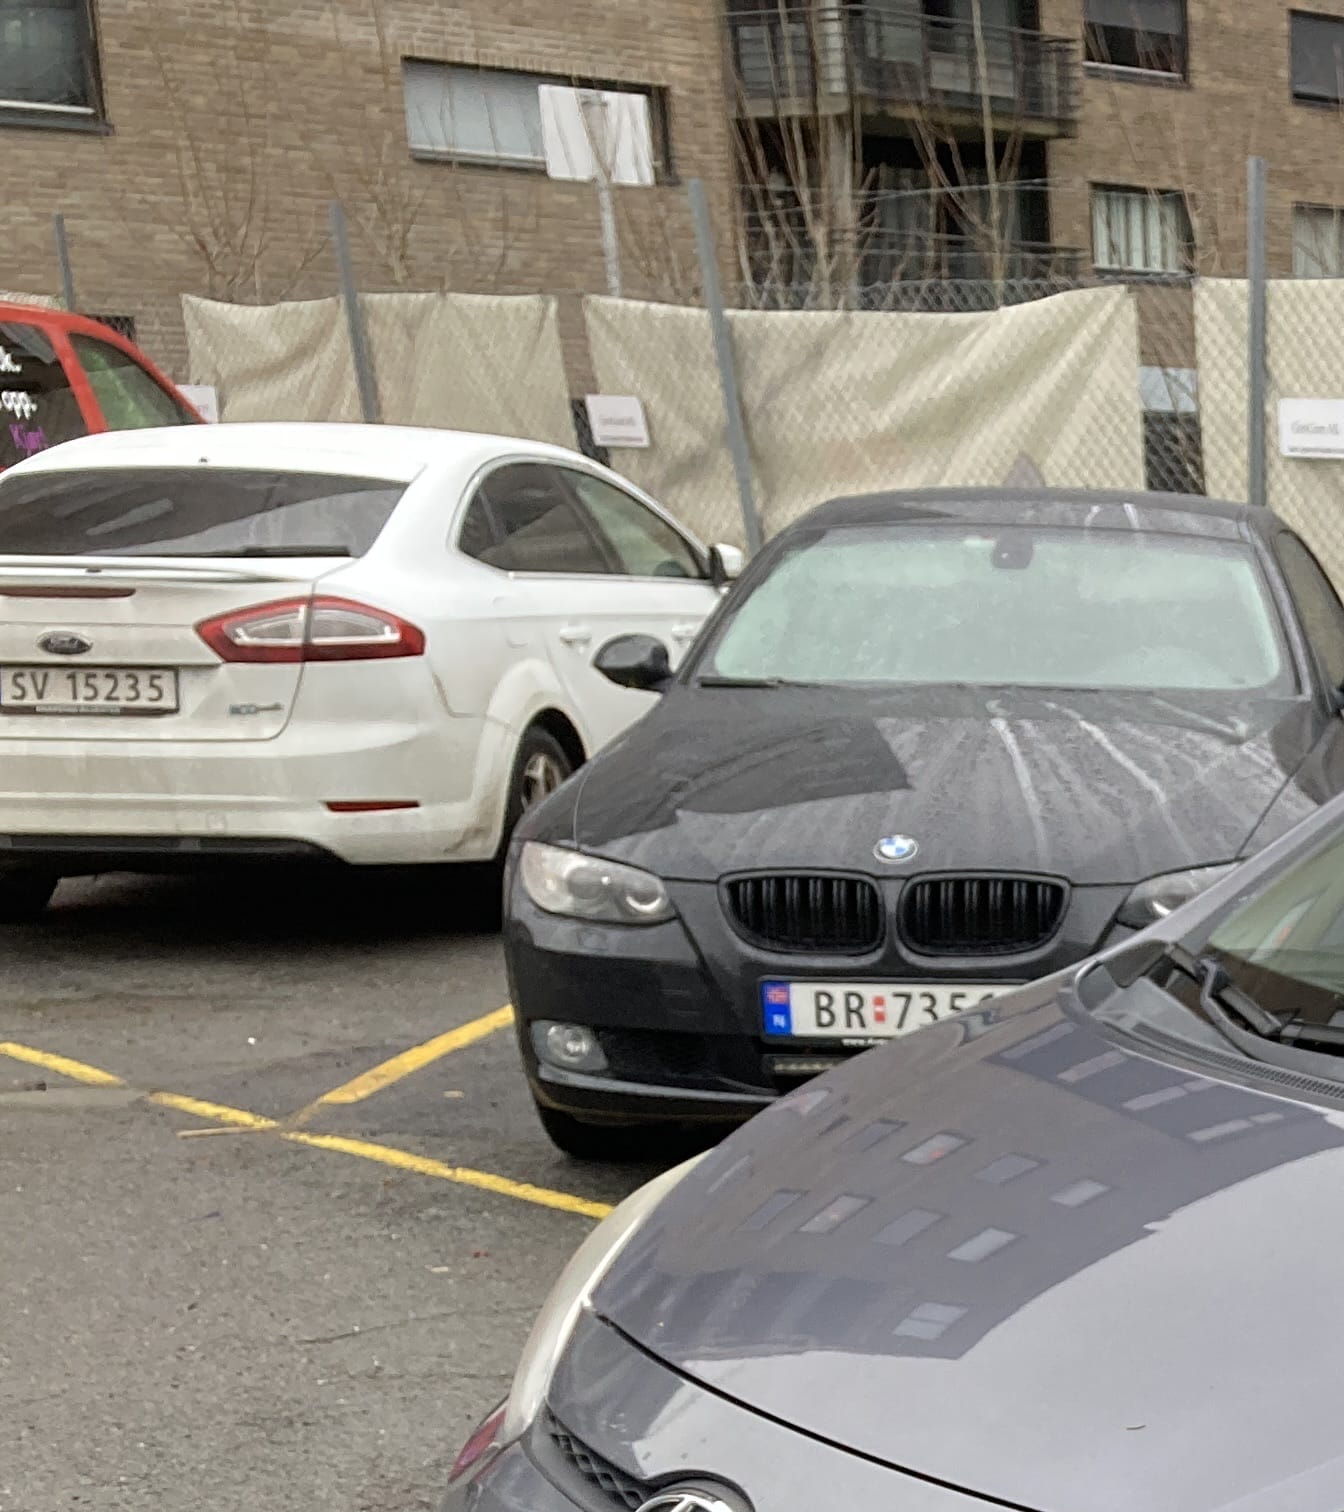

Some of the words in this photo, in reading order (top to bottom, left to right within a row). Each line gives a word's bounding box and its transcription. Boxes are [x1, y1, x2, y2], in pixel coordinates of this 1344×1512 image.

[11, 671, 49, 701] SV
[66, 672, 164, 702] 15235
[814, 990, 867, 1029] BR
[891, 991, 995, 1029] 735
